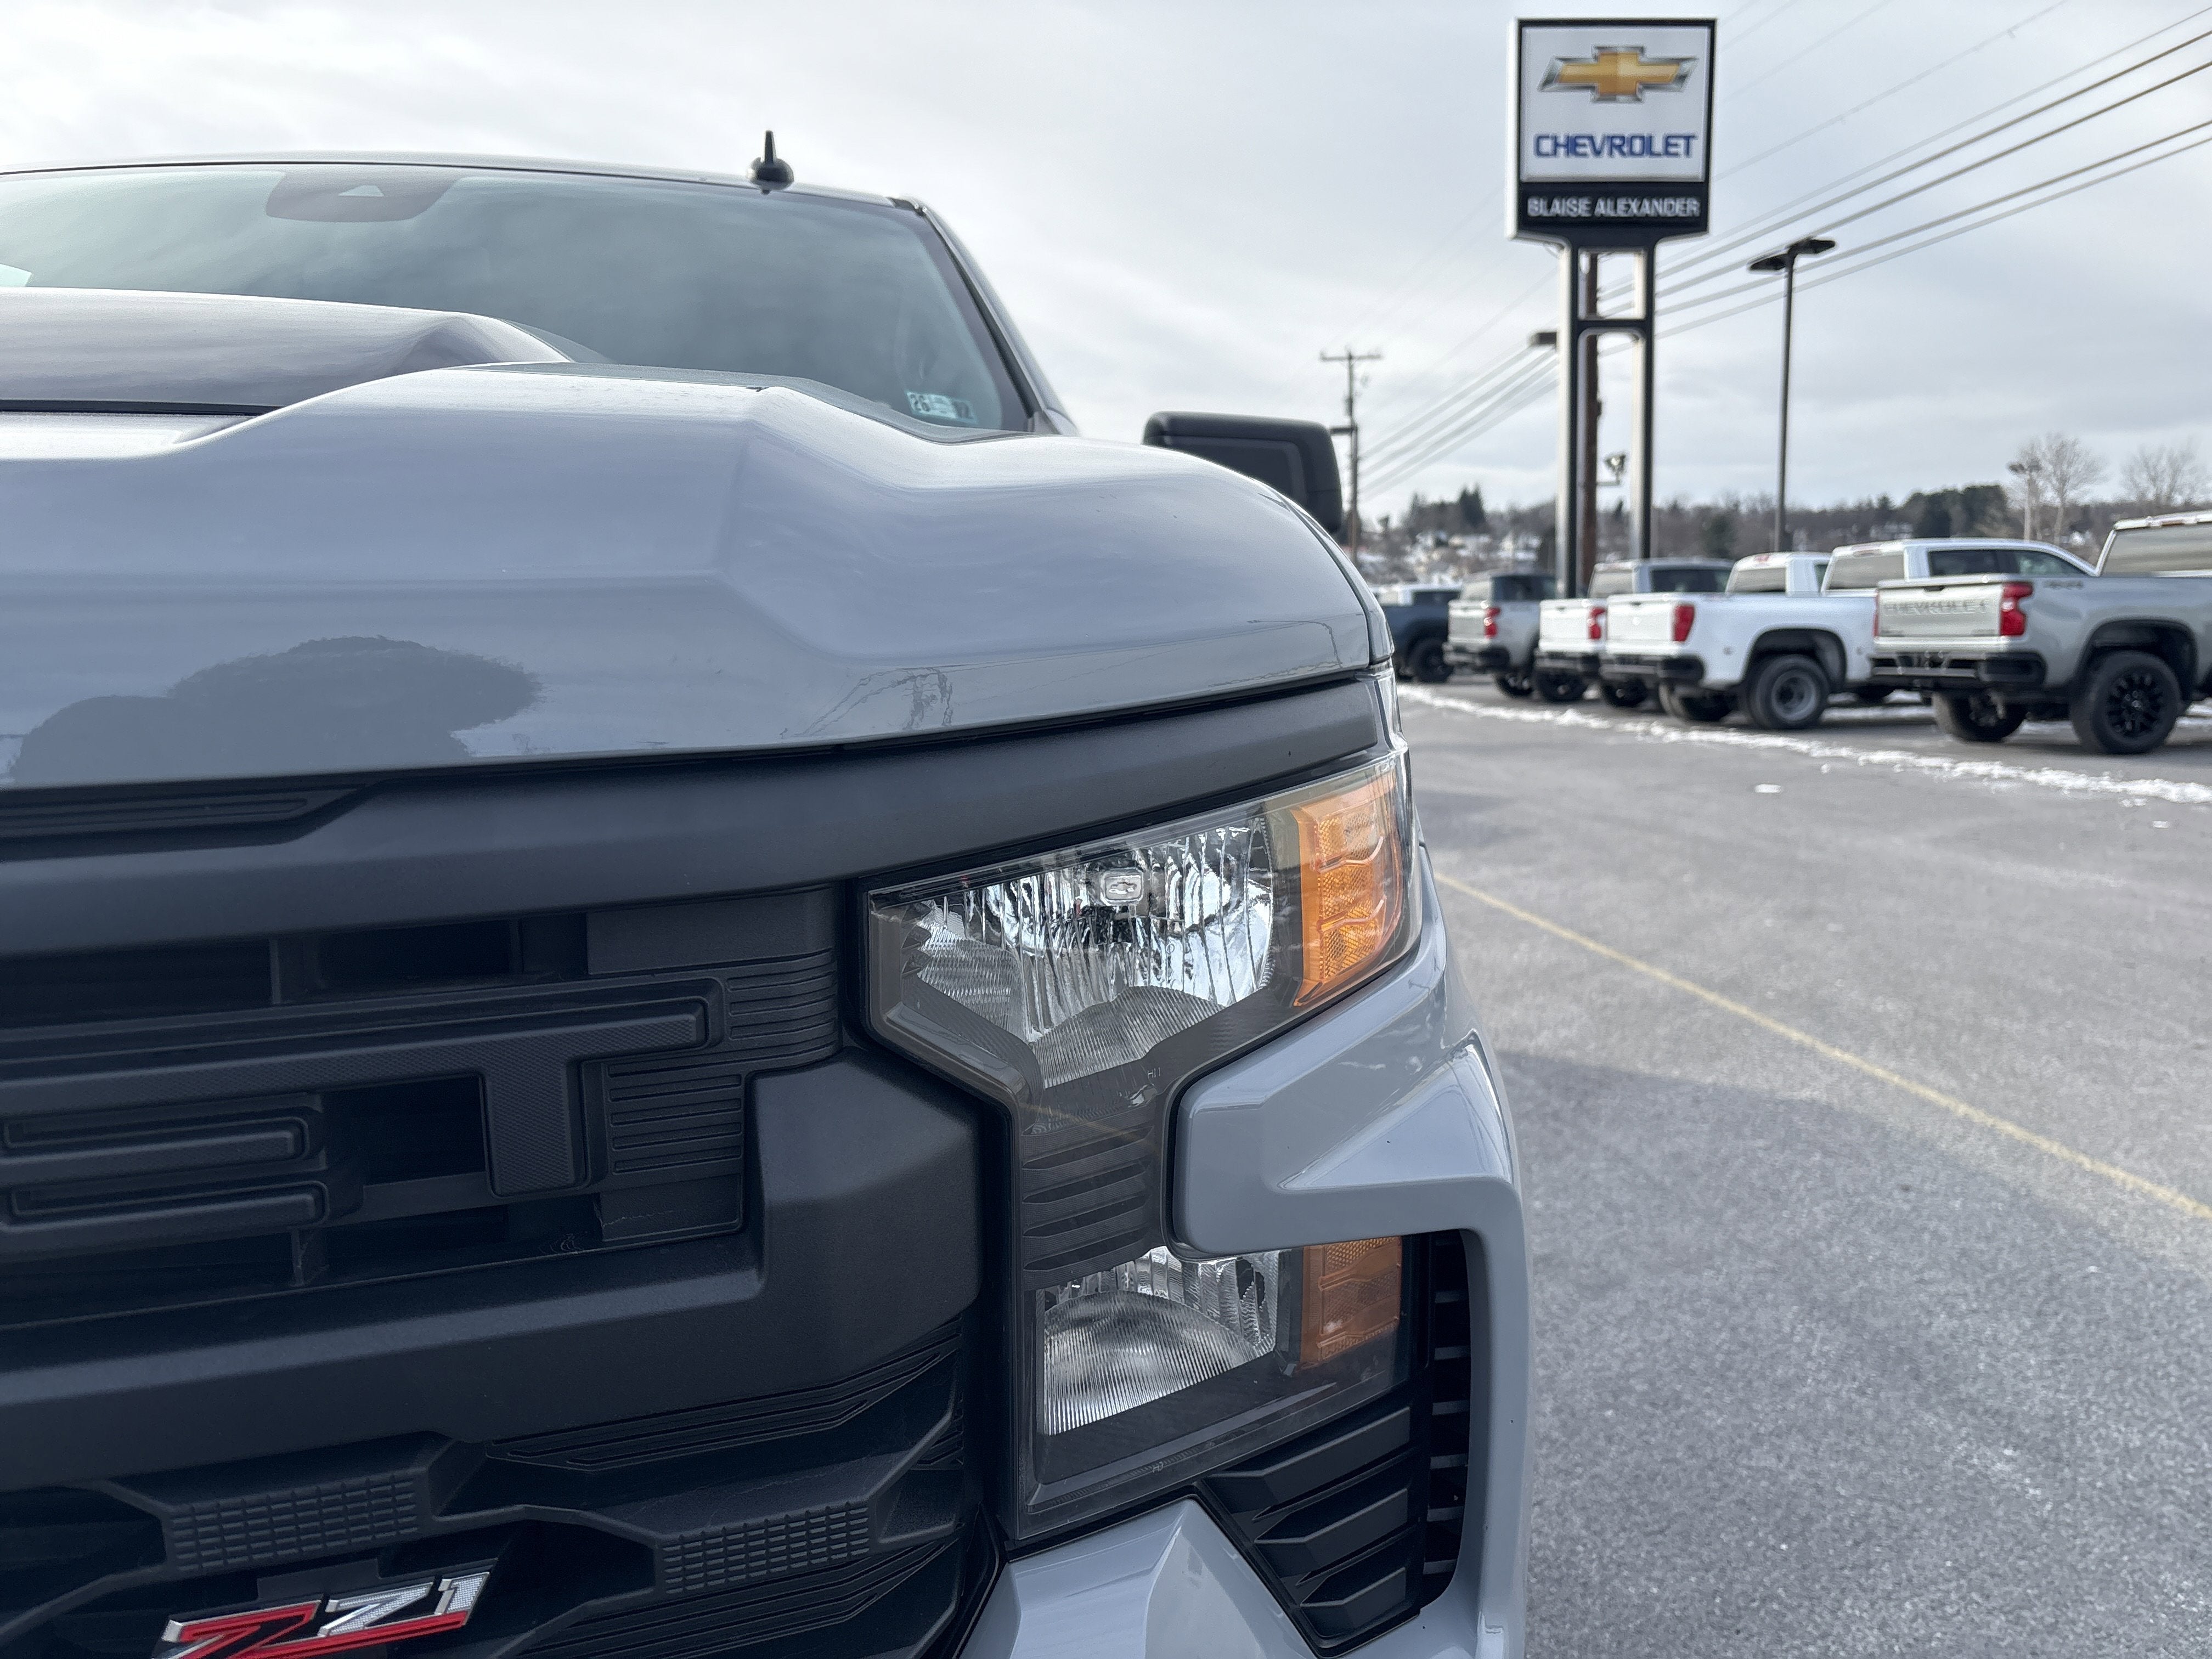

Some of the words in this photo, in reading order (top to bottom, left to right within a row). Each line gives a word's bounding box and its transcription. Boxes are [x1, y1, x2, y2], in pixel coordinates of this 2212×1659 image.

[1534, 134, 1698, 158] CHEVROLET
[1527, 197, 1590, 217] BLAISE
[1594, 198, 1700, 217] ALEXANDER
[153, 1571, 490, 1659] Z71
